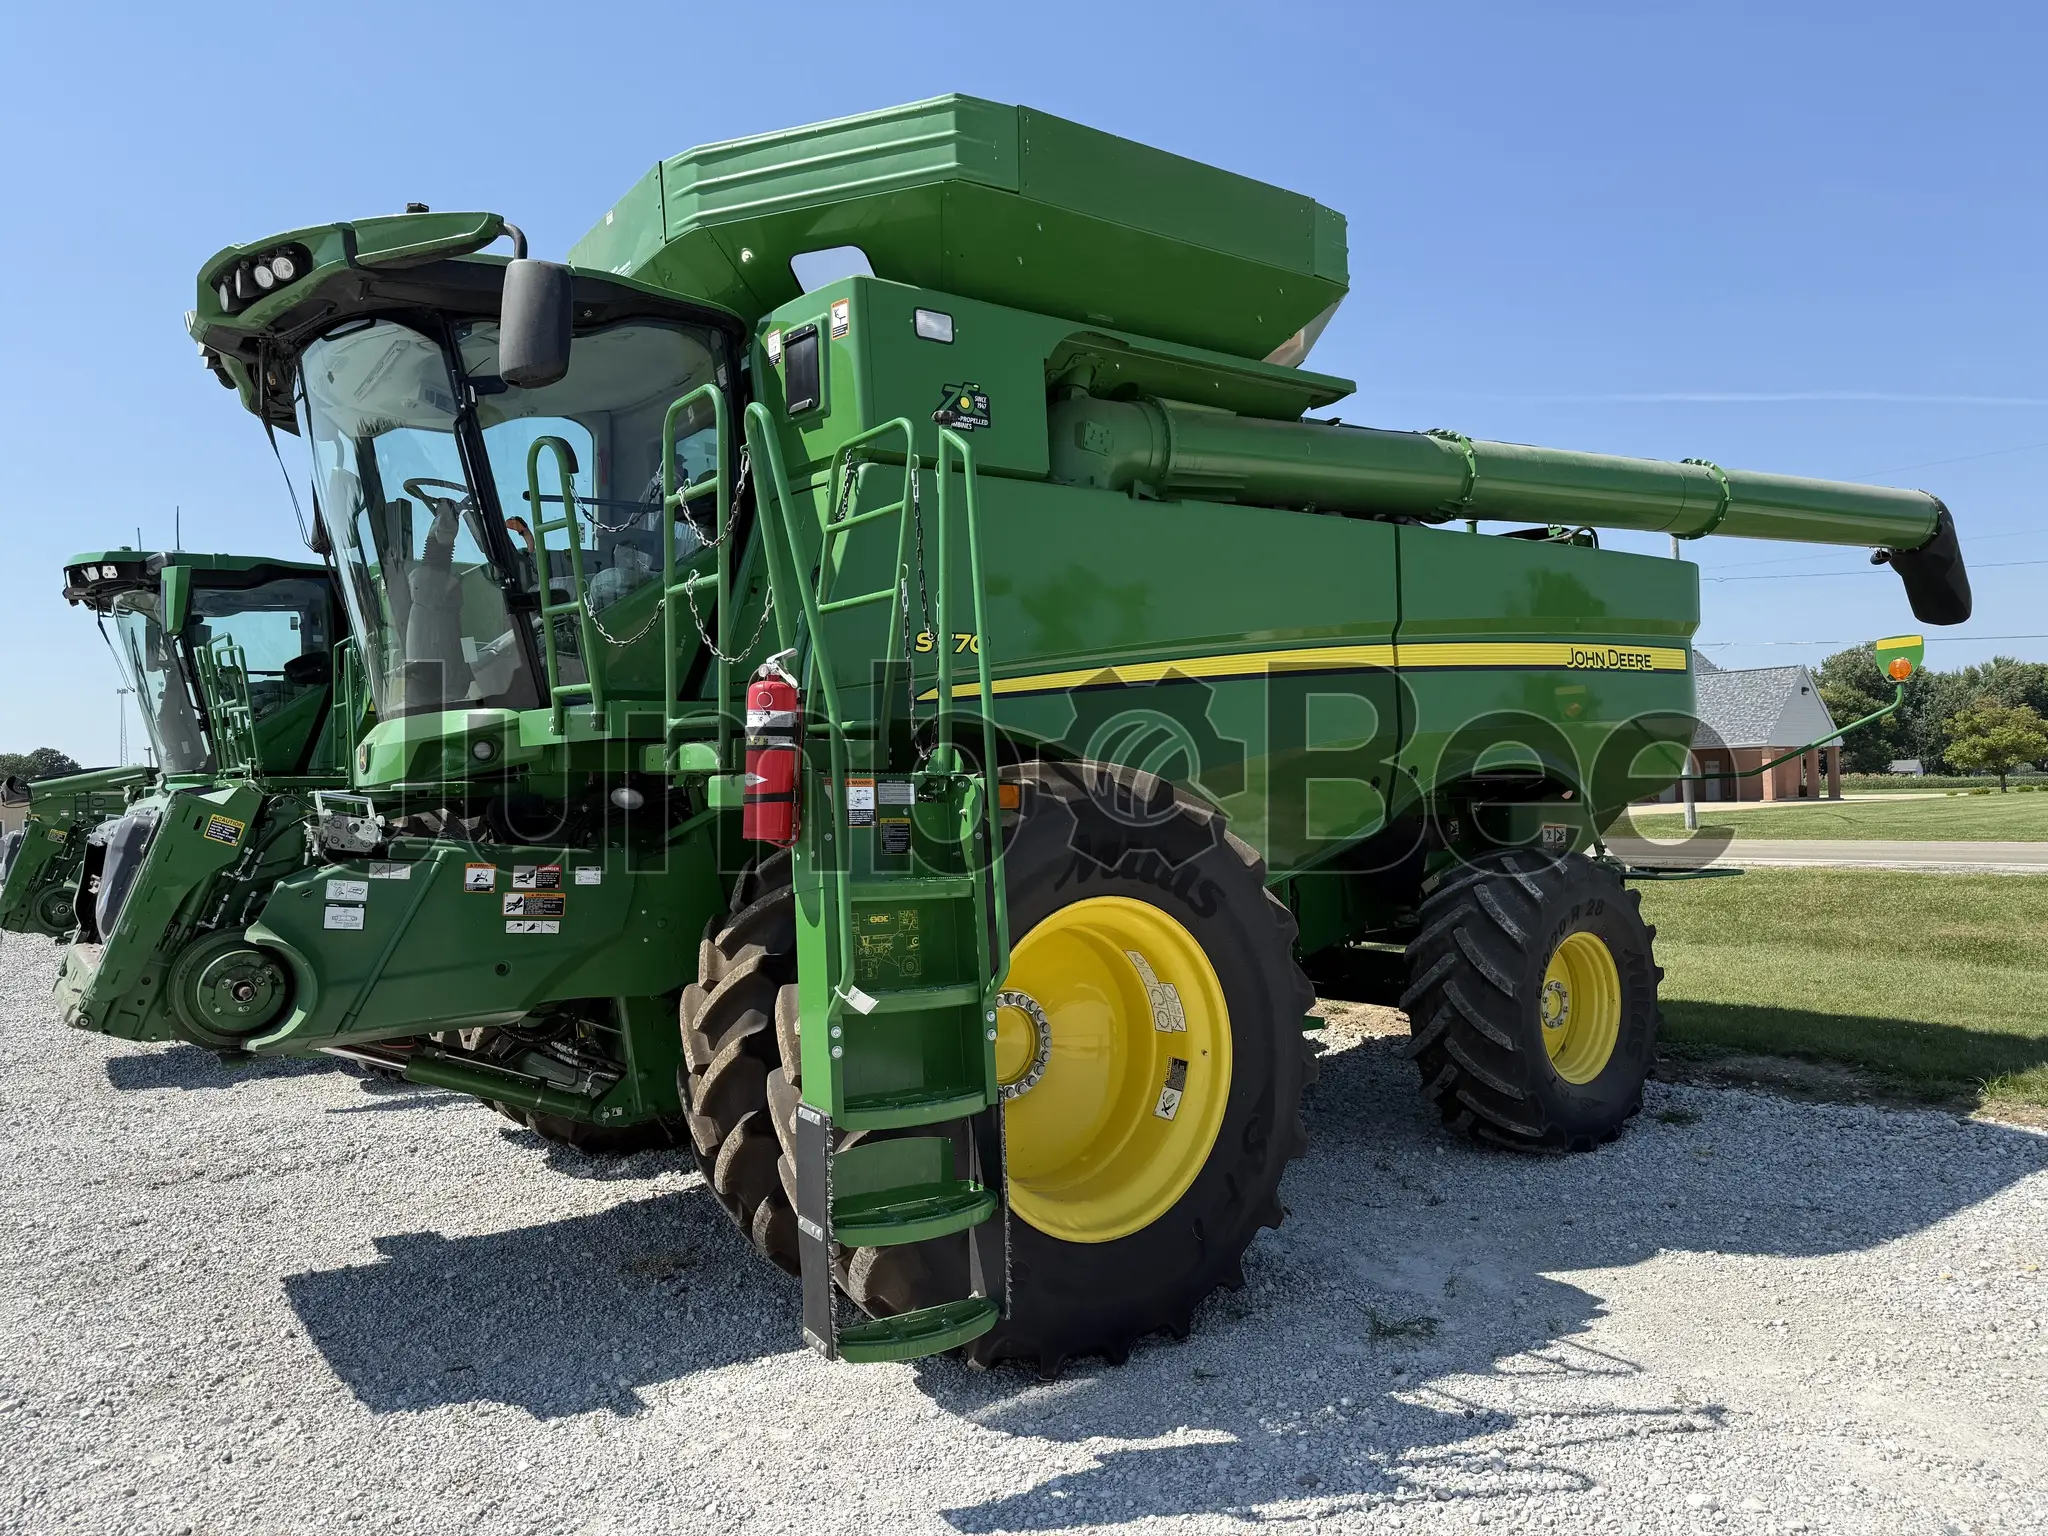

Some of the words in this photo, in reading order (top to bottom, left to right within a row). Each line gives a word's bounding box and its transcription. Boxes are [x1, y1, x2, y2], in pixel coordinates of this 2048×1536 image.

[974, 395, 987, 403] SINCE
[915, 631, 991, 655] S70
[1566, 647, 1606, 667] JOHN
[1608, 649, 1653, 669] DEERE
[217, 816, 244, 828] CAUTION
[1585, 897, 1605, 917] 28
